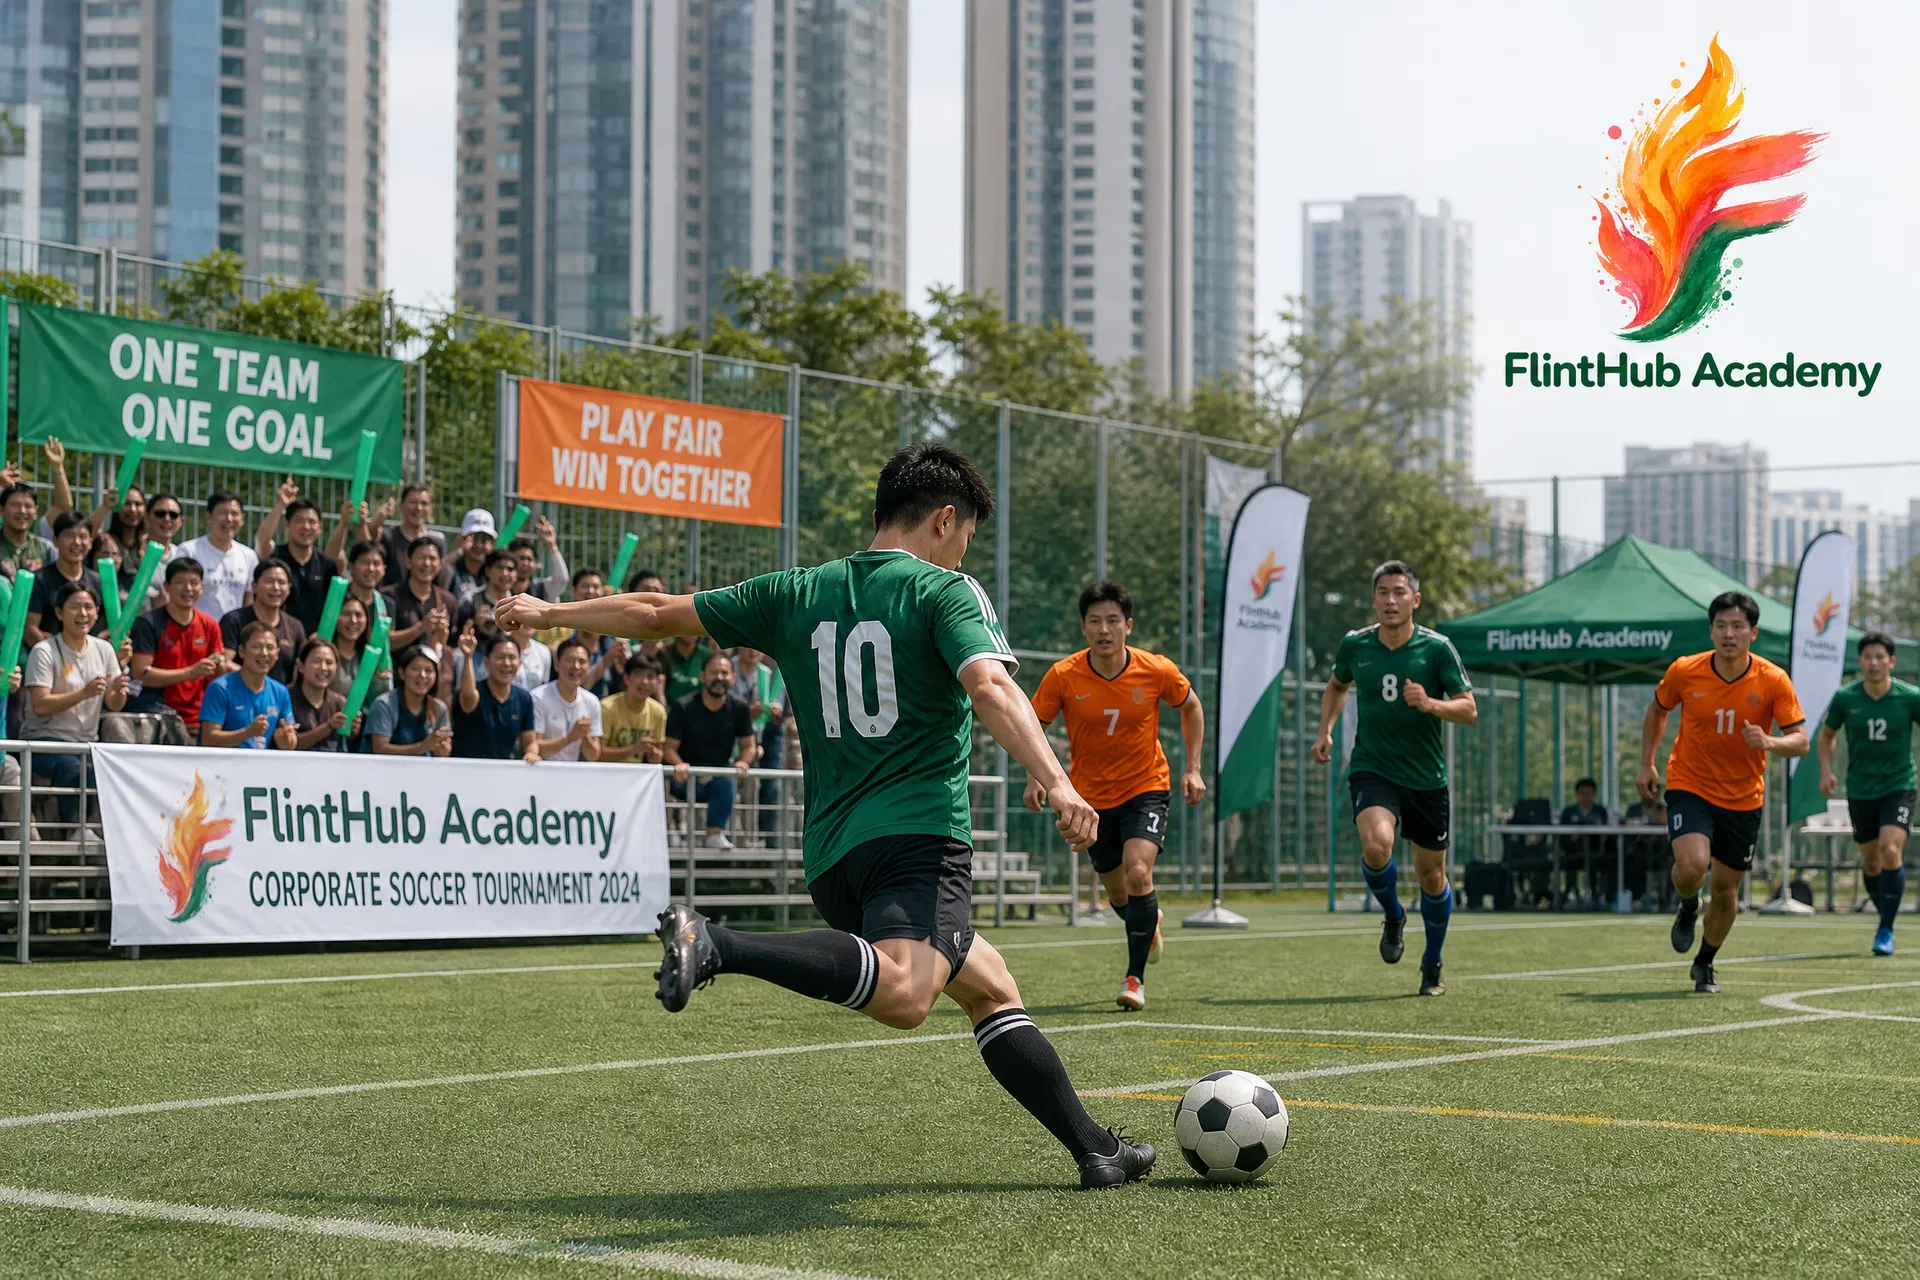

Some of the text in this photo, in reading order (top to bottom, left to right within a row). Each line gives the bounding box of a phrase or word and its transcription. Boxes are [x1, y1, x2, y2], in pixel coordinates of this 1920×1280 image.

[109, 332, 320, 403] ONE TEAM
[122, 392, 333, 461] ONE GOAL
[580, 401, 724, 459] PLAY FAIR
[551, 446, 752, 508] WIN TOGETHER
[1486, 626, 1674, 651] FlintHub Academy
[810, 620, 899, 738] 10
[1381, 673, 1398, 702] 8
[1103, 708, 1120, 736] 7
[1714, 708, 1736, 735] 11
[1866, 718, 1887, 741] 12
[242, 786, 616, 859] FlintHub Academy
[248, 871, 641, 907] CORPORATE SOCCER TOURNAMENT 2024
